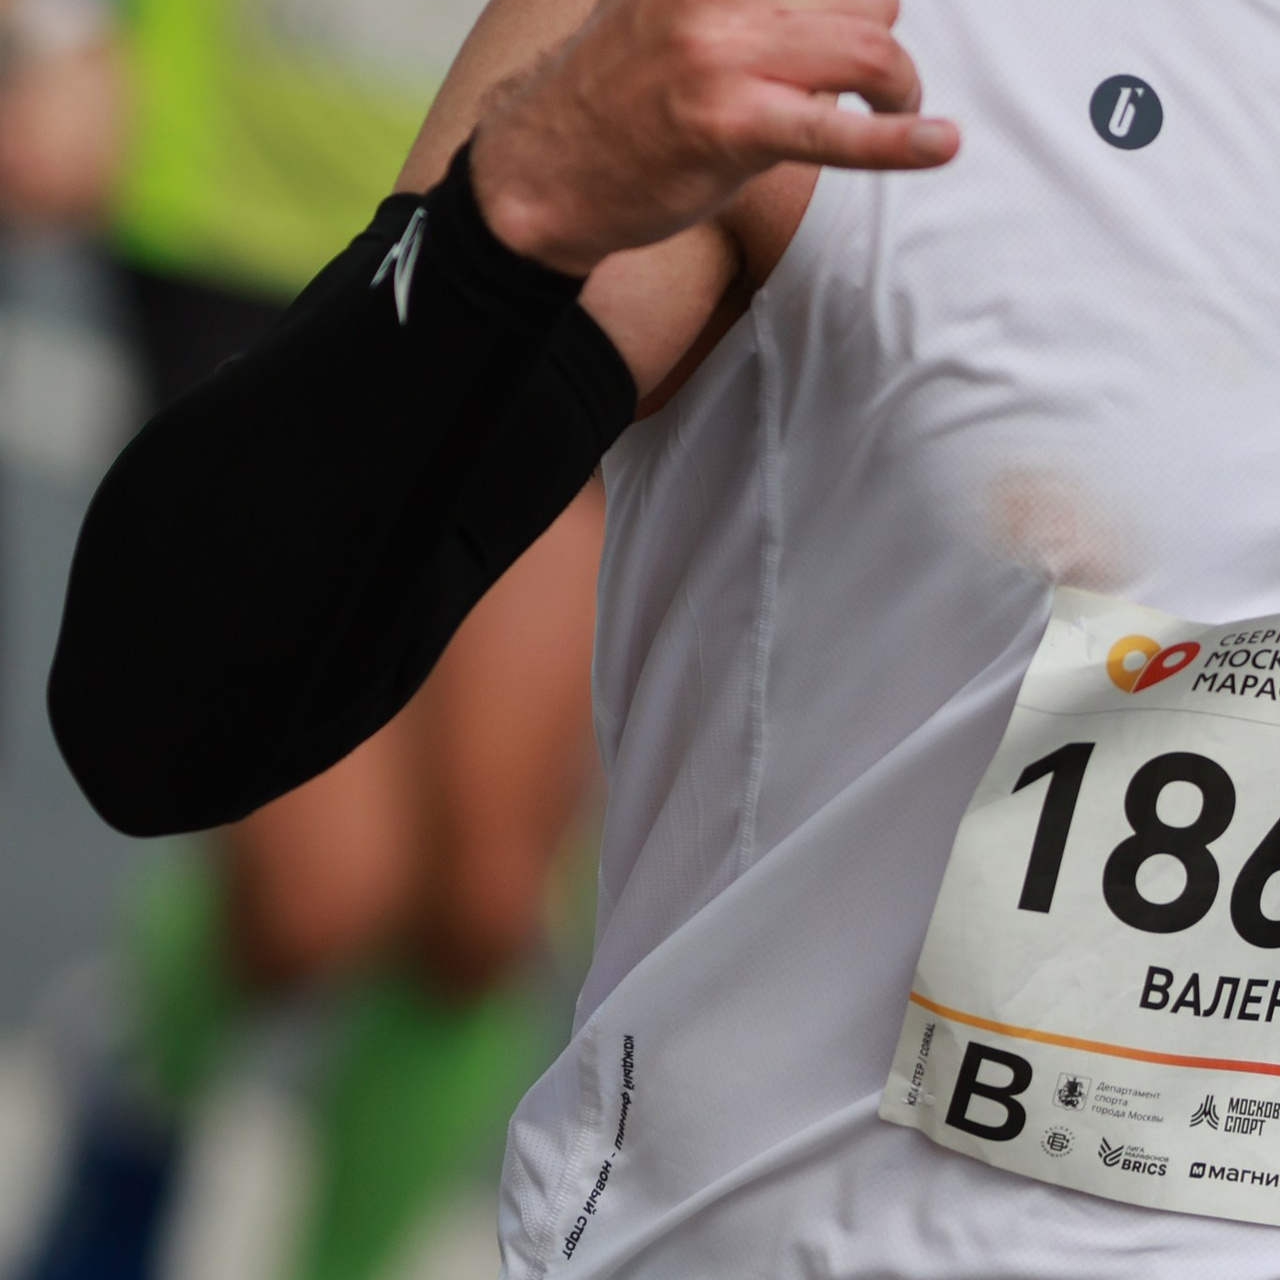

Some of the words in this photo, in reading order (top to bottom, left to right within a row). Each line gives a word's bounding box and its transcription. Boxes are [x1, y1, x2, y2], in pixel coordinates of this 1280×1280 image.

[623, 1034, 635, 1091] каждый
[1094, 1093, 1129, 1107] спорта
[1096, 1081, 1161, 1100] Департамент
[614, 1092, 633, 1151] финиш
[1091, 1104, 1126, 1119] города
[1127, 1110, 1165, 1123] Москвы
[1223, 1115, 1267, 1136] СПОРТ
[1121, 1158, 1168, 1176] BRICS
[582, 1159, 613, 1216] новый
[561, 1216, 588, 1261] старт
